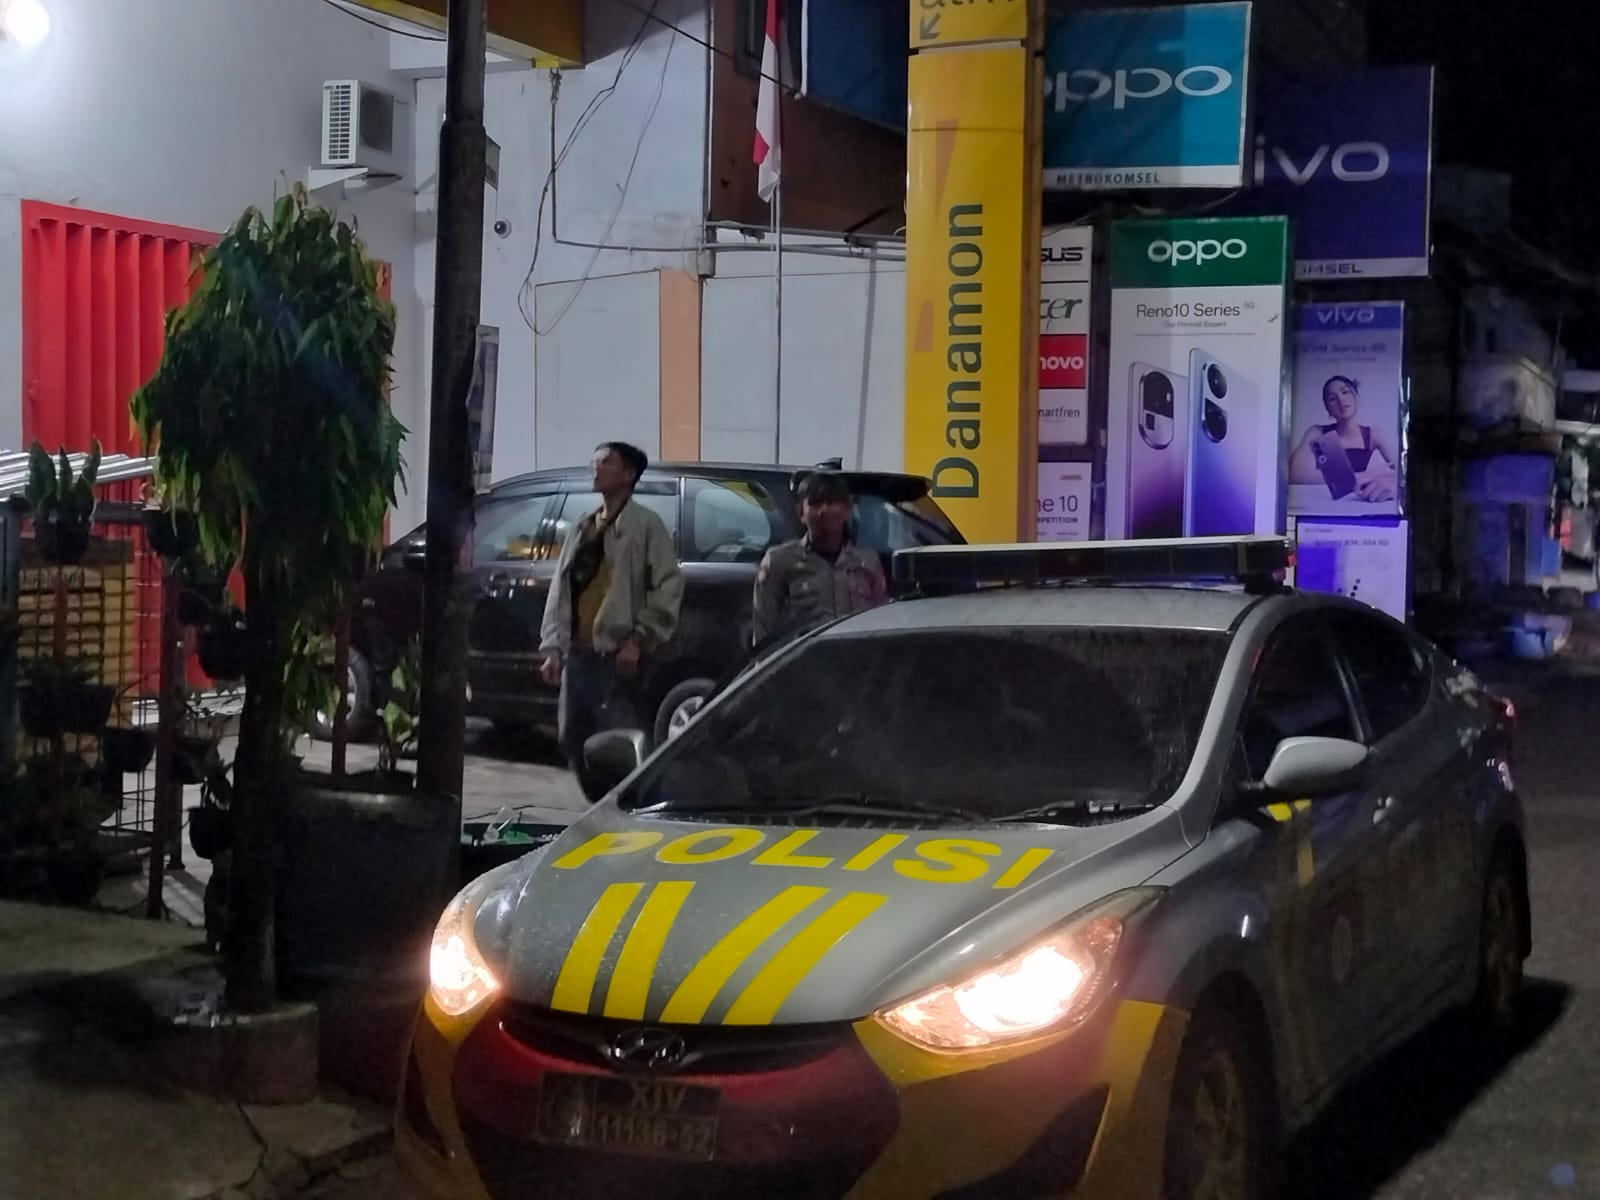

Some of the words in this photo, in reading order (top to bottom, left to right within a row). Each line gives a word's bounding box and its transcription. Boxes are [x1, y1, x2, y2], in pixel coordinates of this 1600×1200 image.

[1044, 65, 1232, 112] ppo
[1254, 134, 1389, 186] ivo
[1056, 172, 1160, 185] METROKOMSEL
[1147, 238, 1247, 267] oppo
[1136, 303, 1190, 318] Reno10
[1193, 302, 1241, 317] Series
[1317, 306, 1375, 324] vivo
[931, 203, 983, 499] Danamon
[1040, 355, 1084, 371] novo
[1038, 406, 1080, 418] martfren
[1059, 494, 1078, 513] 10
[551, 827, 1056, 890] POLISI
